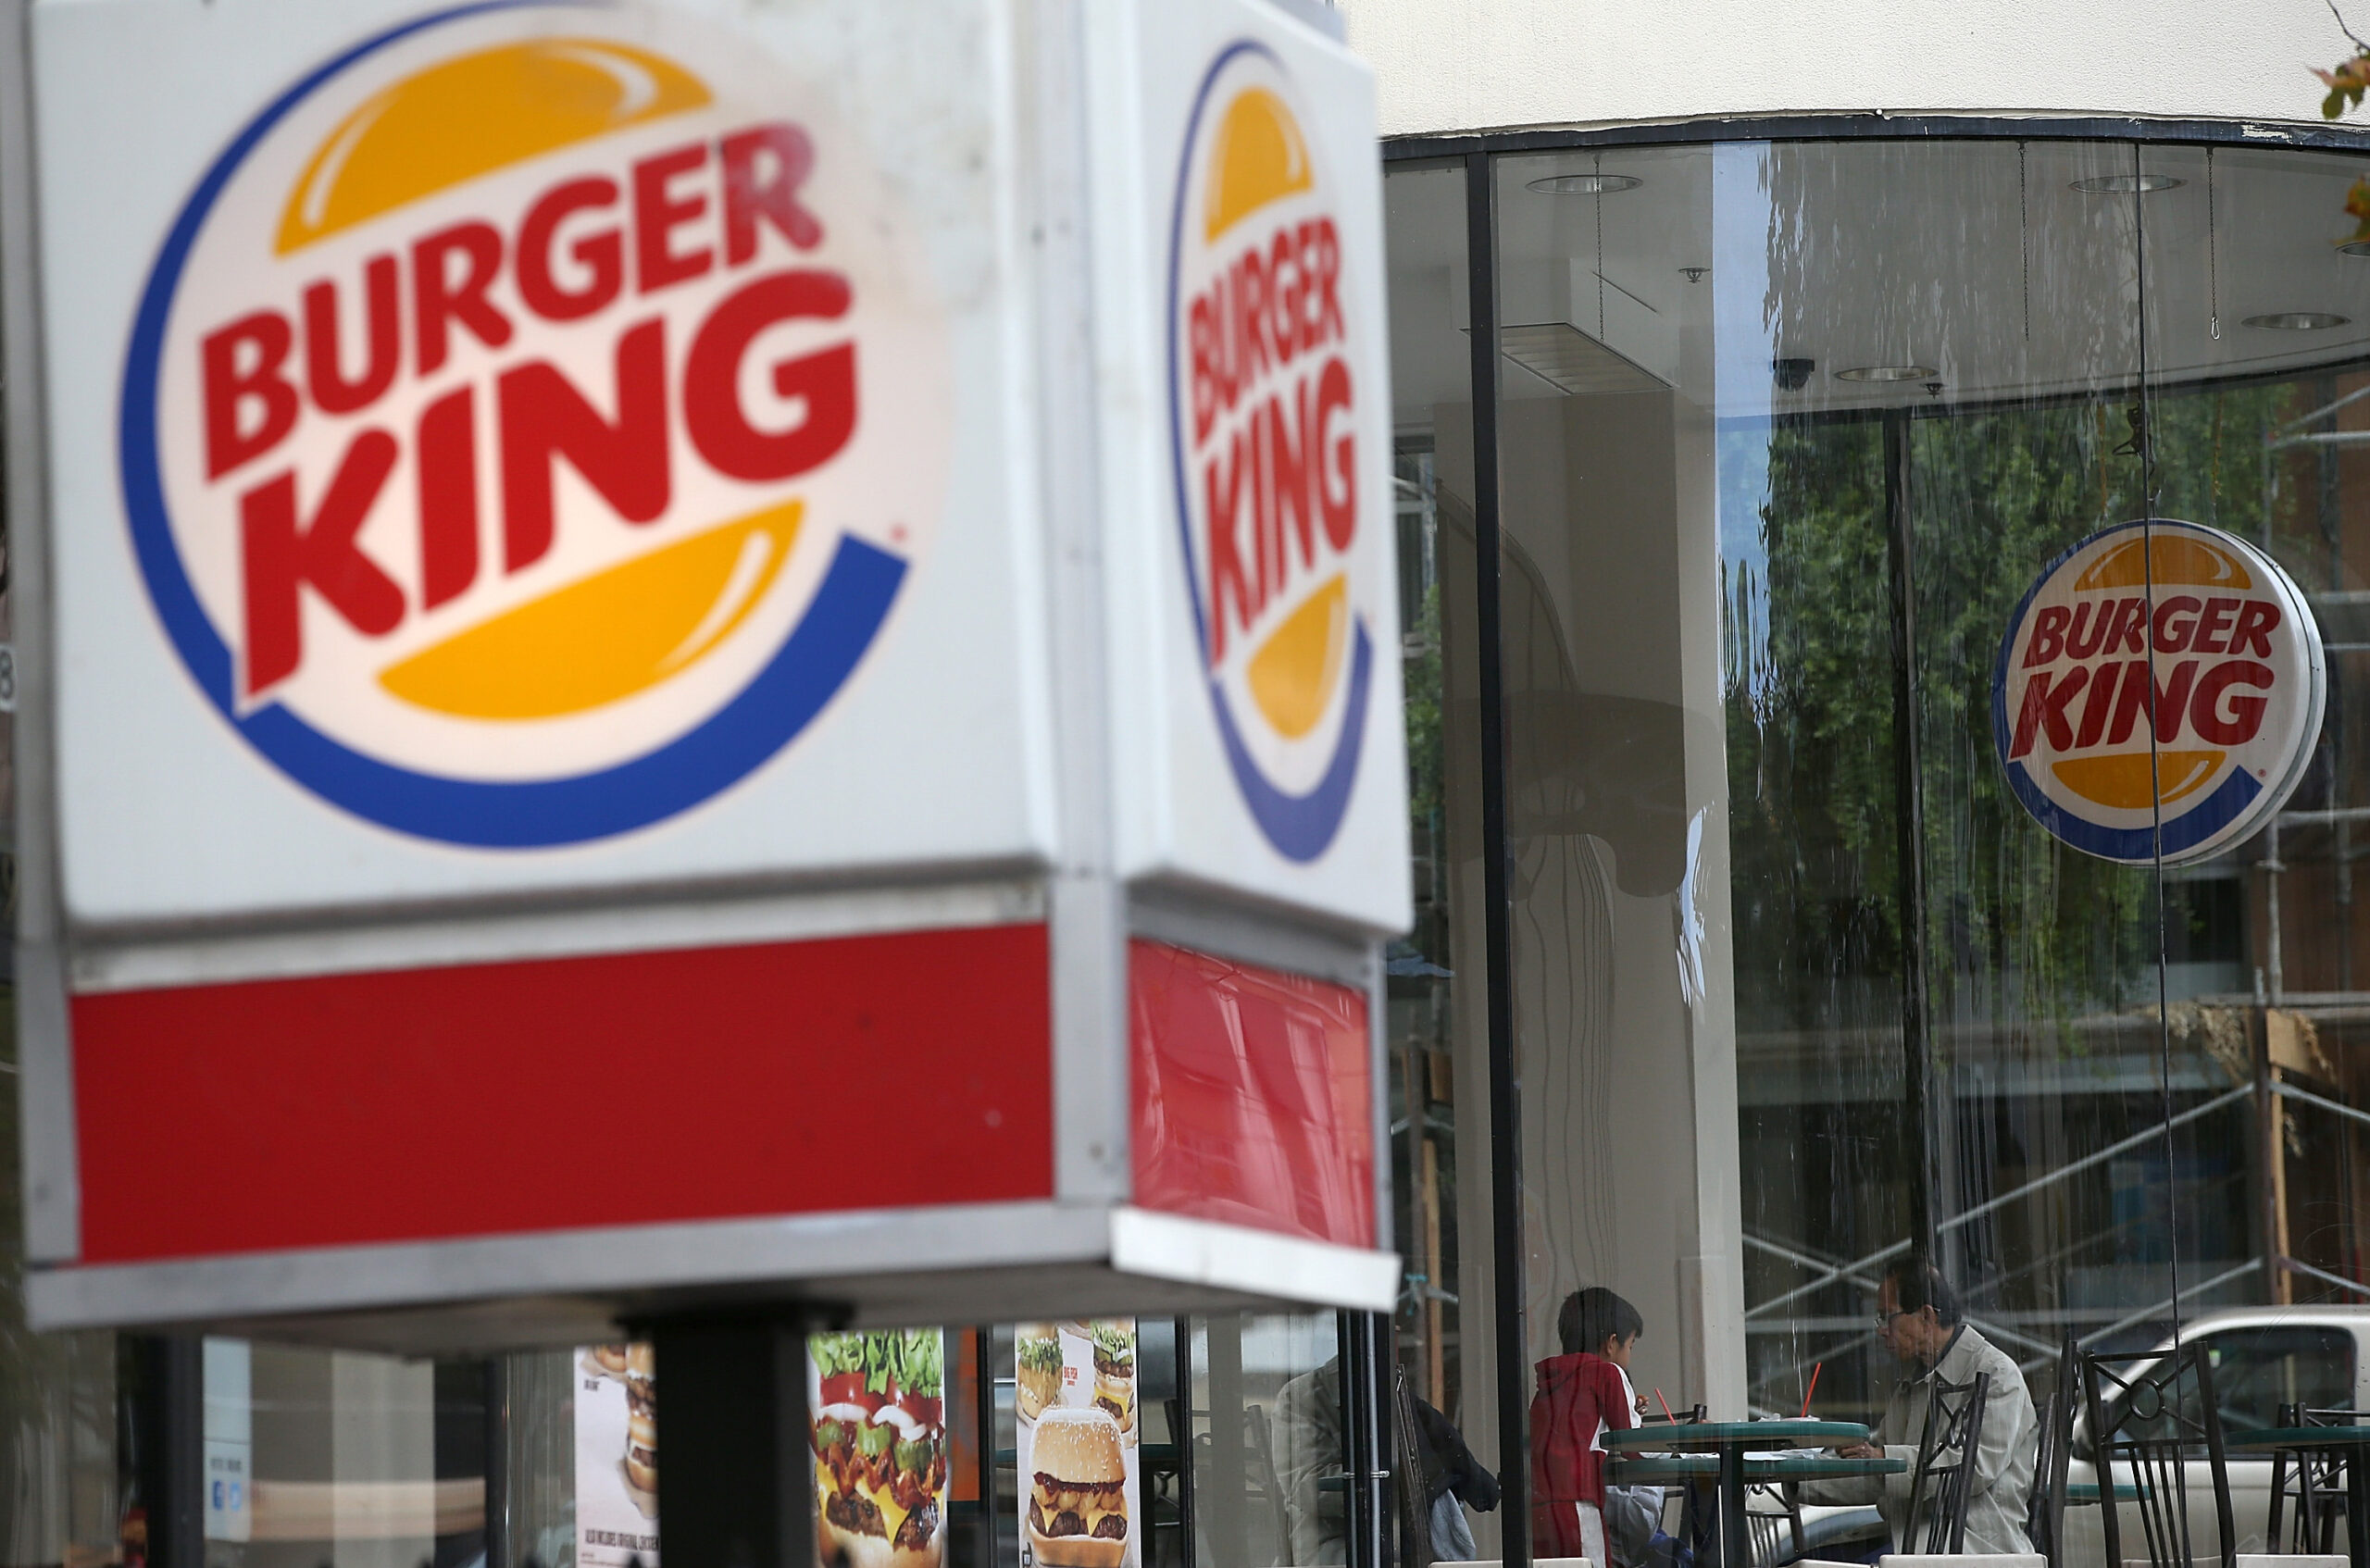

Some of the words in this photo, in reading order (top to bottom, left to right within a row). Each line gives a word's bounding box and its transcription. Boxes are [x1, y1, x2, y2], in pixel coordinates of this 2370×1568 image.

[199, 119, 826, 487] BURGER
[1188, 215, 1345, 451] BURGER
[236, 268, 861, 702] KING
[1205, 355, 1357, 670] KING
[2009, 660, 2275, 759] KING
[2022, 596, 2281, 669] BURGER
